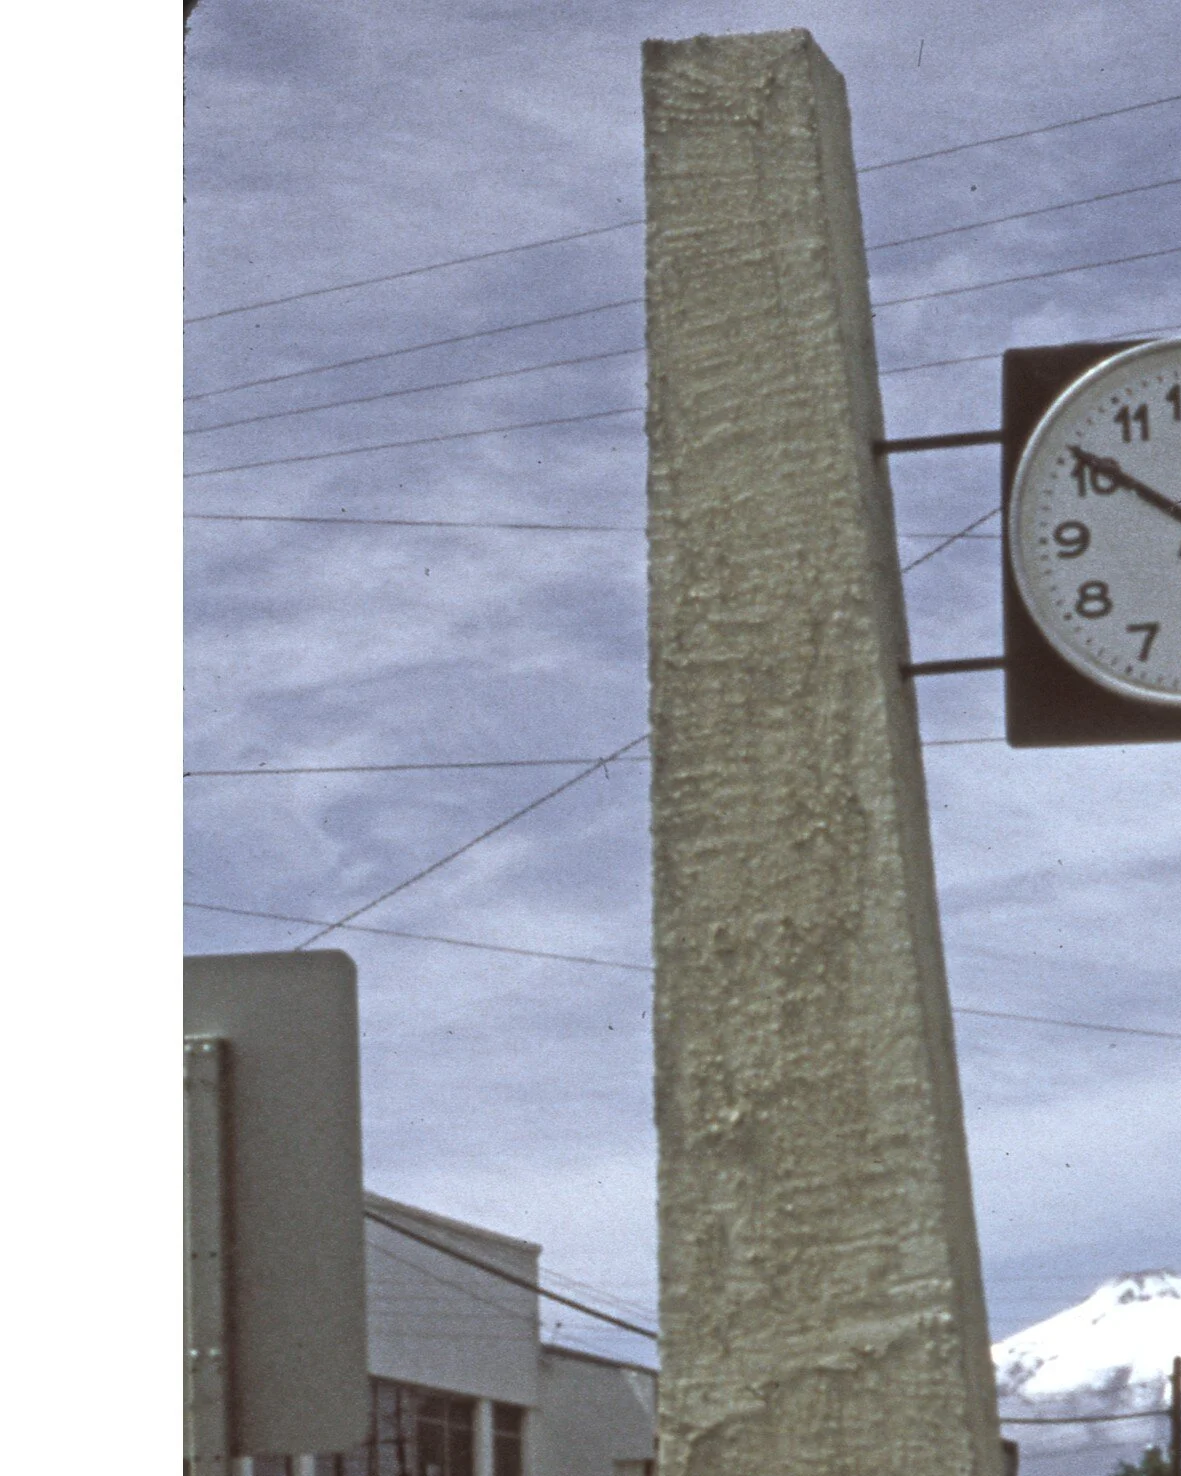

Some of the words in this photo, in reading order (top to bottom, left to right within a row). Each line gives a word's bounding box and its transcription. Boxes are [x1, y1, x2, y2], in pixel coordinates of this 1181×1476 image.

[1113, 403, 1150, 444] 11
[1070, 456, 1122, 498] 10
[1053, 520, 1091, 560] 9
[1074, 580, 1113, 620] 8
[1126, 622, 1160, 662] 7
